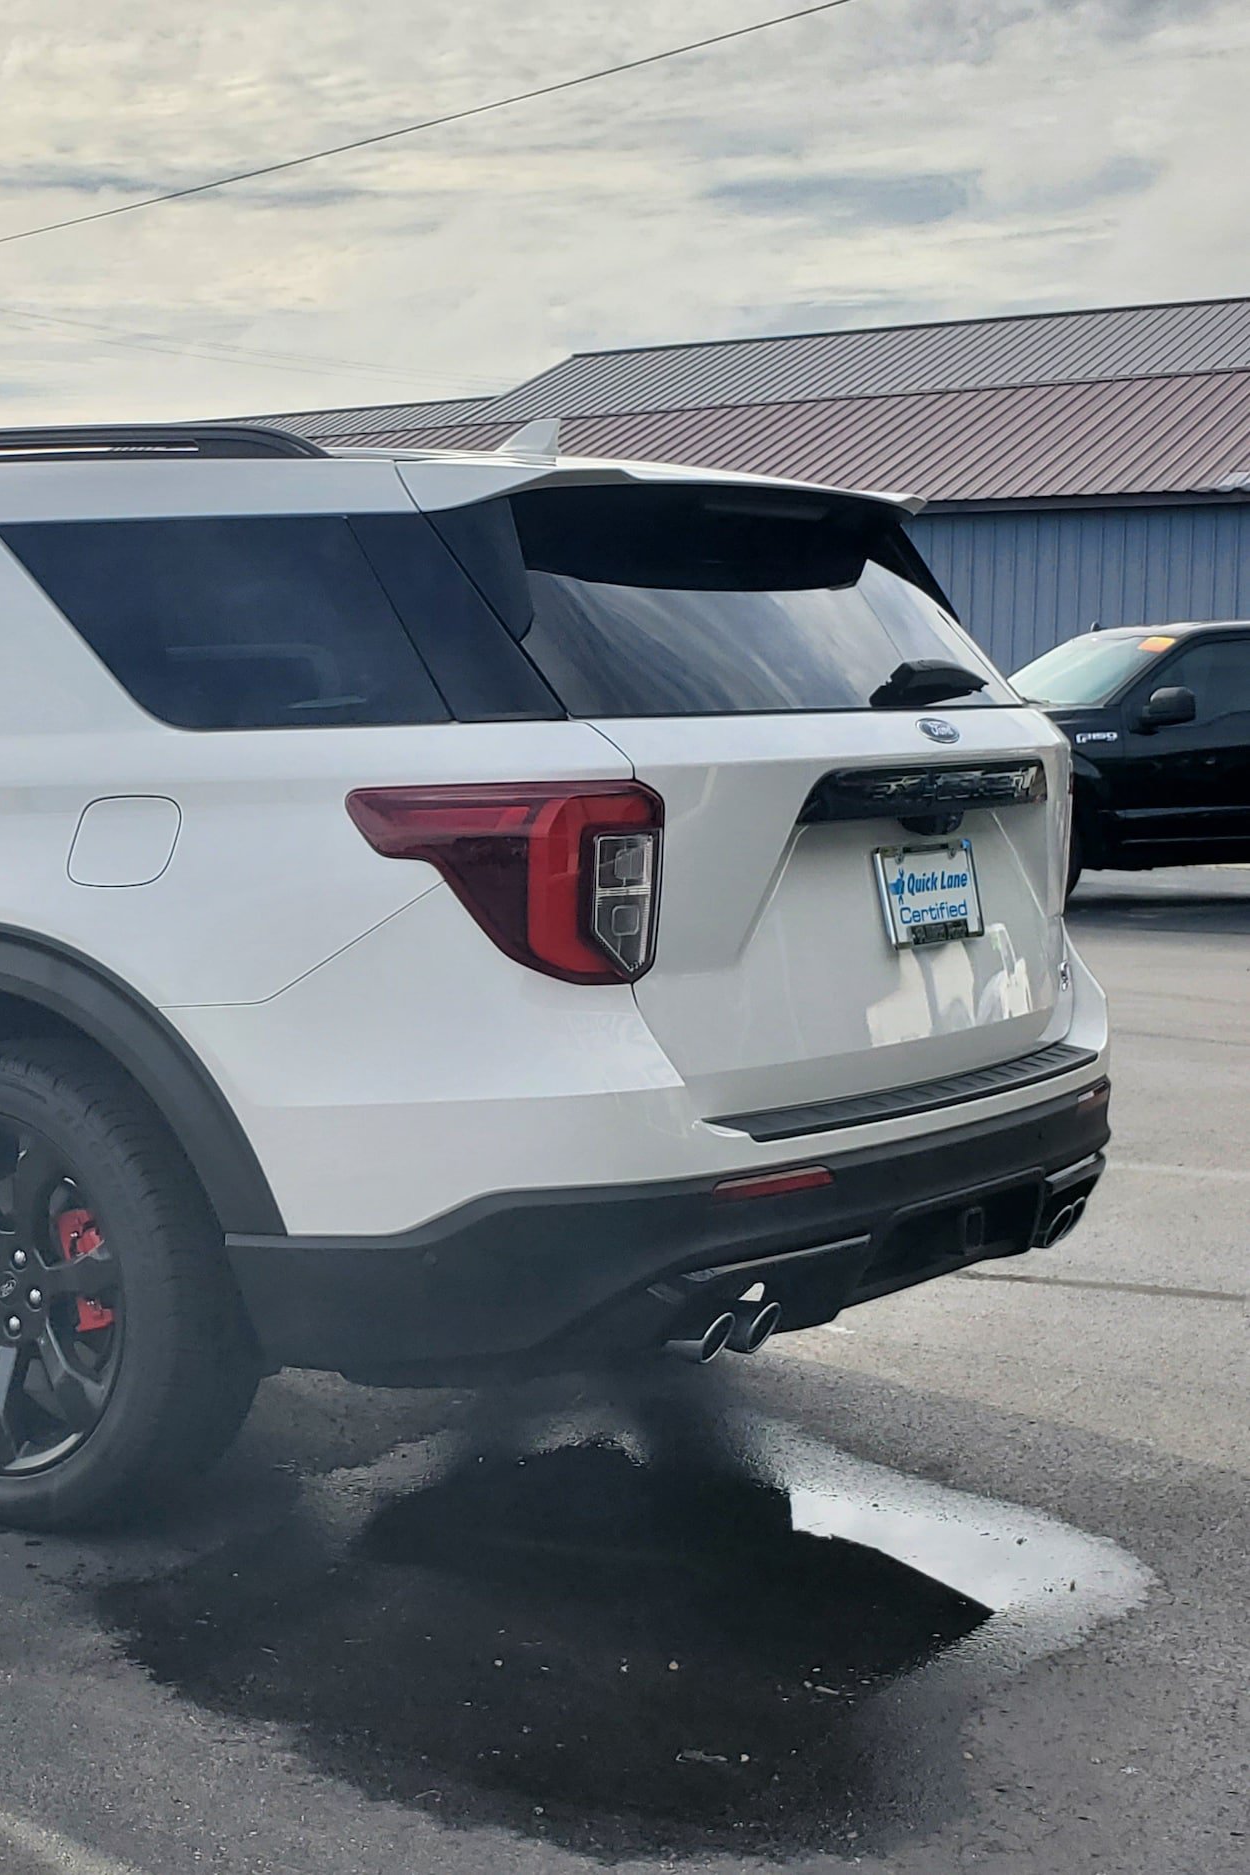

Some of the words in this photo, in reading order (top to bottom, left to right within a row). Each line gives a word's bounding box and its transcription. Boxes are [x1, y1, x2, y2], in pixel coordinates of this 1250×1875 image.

[907, 871, 938, 896] Quick
[940, 870, 969, 890] Lane
[899, 899, 969, 925] Certified
